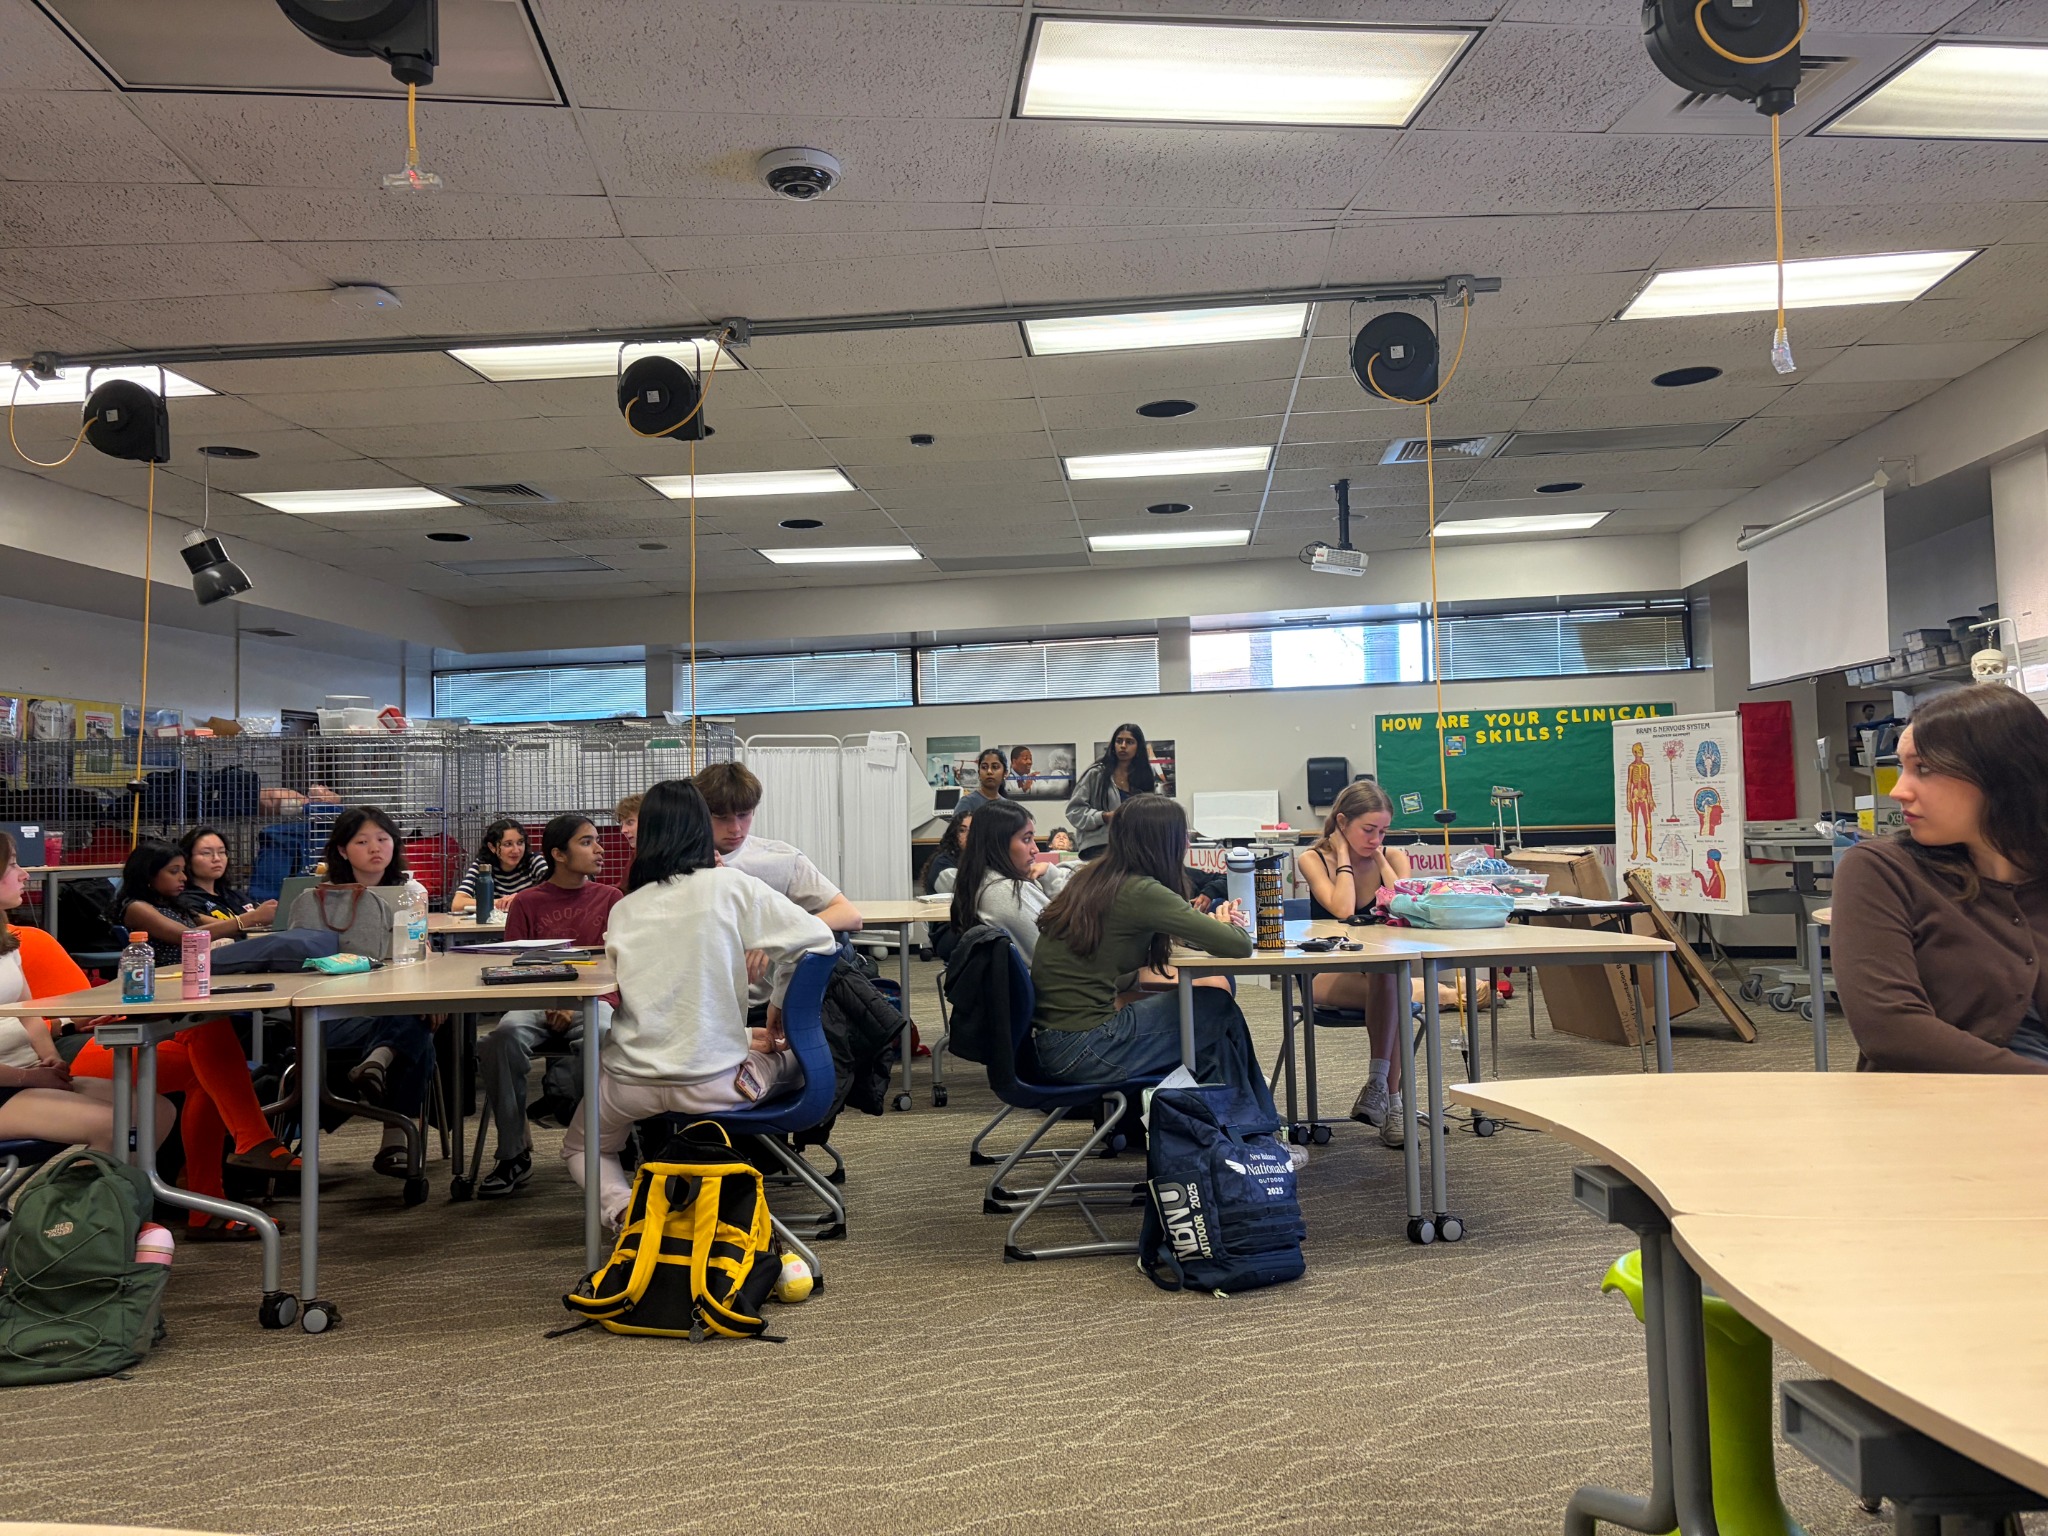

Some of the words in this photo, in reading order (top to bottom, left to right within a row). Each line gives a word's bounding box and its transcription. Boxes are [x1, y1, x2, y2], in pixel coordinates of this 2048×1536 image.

[1381, 717, 1422, 732] HOW
[1435, 714, 1470, 729] ARE
[1484, 711, 1540, 727] YOUR
[1555, 705, 1661, 724] CLINICAL
[1635, 727, 1652, 735] BRAIN
[1658, 724, 1686, 733] NERVOUS
[1686, 722, 1711, 731] SYSTEM
[1889, 813, 1903, 825] X9
[1245, 1162, 1288, 1175] Nationals
[1186, 1182, 1201, 1209] 2025
[1267, 1187, 1284, 1196] 2025
[1194, 1213, 1214, 1259] OUTDOOR
